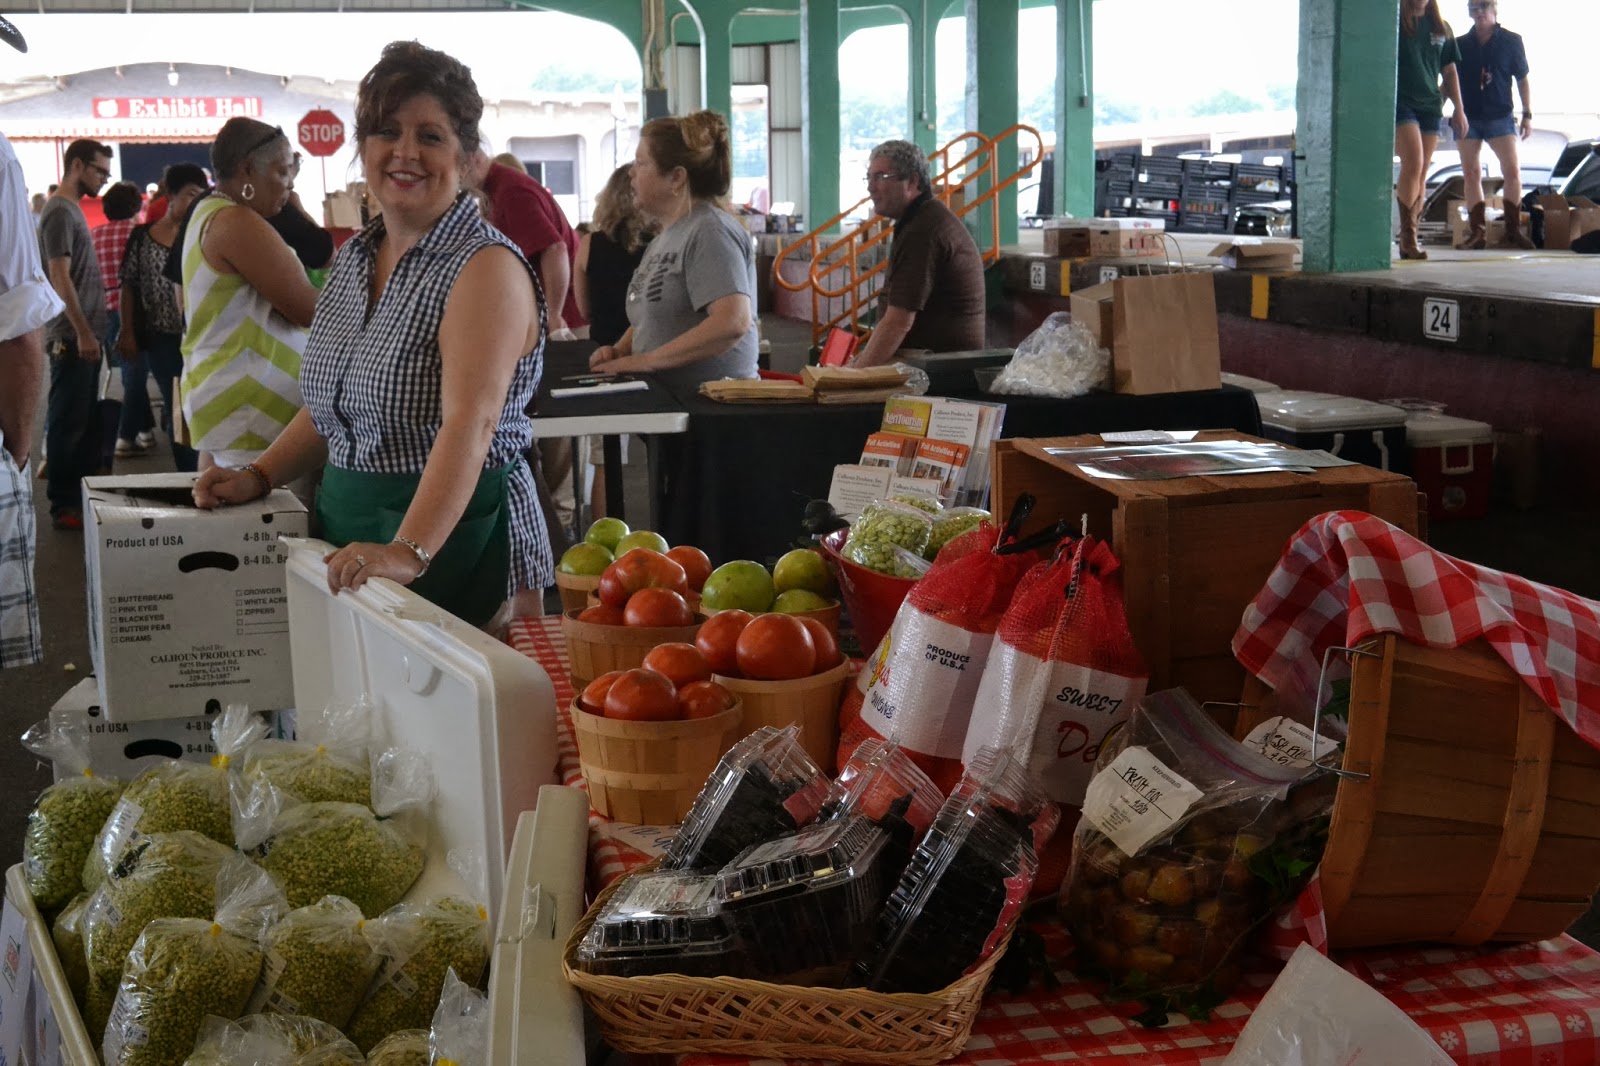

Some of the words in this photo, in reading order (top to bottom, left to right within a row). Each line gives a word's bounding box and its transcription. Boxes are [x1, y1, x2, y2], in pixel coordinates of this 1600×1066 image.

[129, 98, 207, 118] Exhibit
[215, 98, 258, 117] Hall
[300, 124, 343, 142] STOP
[1430, 305, 1451, 333] 24
[876, 439, 900, 448] Activities
[921, 442, 930, 450] Fall
[930, 444, 954, 456] Activities
[243, 532, 259, 541] 4-8
[261, 531, 274, 541] lb.
[106, 538, 146, 548] Product
[149, 537, 159, 546] of
[163, 535, 184, 546] USA
[267, 544, 276, 552] or
[244, 555, 259, 565] 8-4
[262, 554, 274, 564] lb.
[243, 588, 281, 596] CROWDER
[117, 594, 174, 603] BUTTERBEANS
[138, 604, 158, 612] EYES
[244, 607, 275, 615] ZIPPERS
[118, 614, 165, 623] BLACKEYES
[119, 625, 149, 633] BUTTER
[119, 635, 152, 643] CREAMS
[150, 653, 198, 664] CALHOUN
[200, 649, 245, 660] PRODUCE
[247, 648, 267, 657] INC.
[925, 652, 938, 661] OF
[927, 644, 970, 663] PRODUCE
[1057, 687, 1122, 714] SWEET
[95, 723, 105, 732] of
[108, 723, 129, 733] USA
[186, 722, 202, 731] 4-8
[187, 744, 202, 753] 8-4
[204, 743, 217, 753] lb.
[1122, 767, 1150, 792] FRESH
